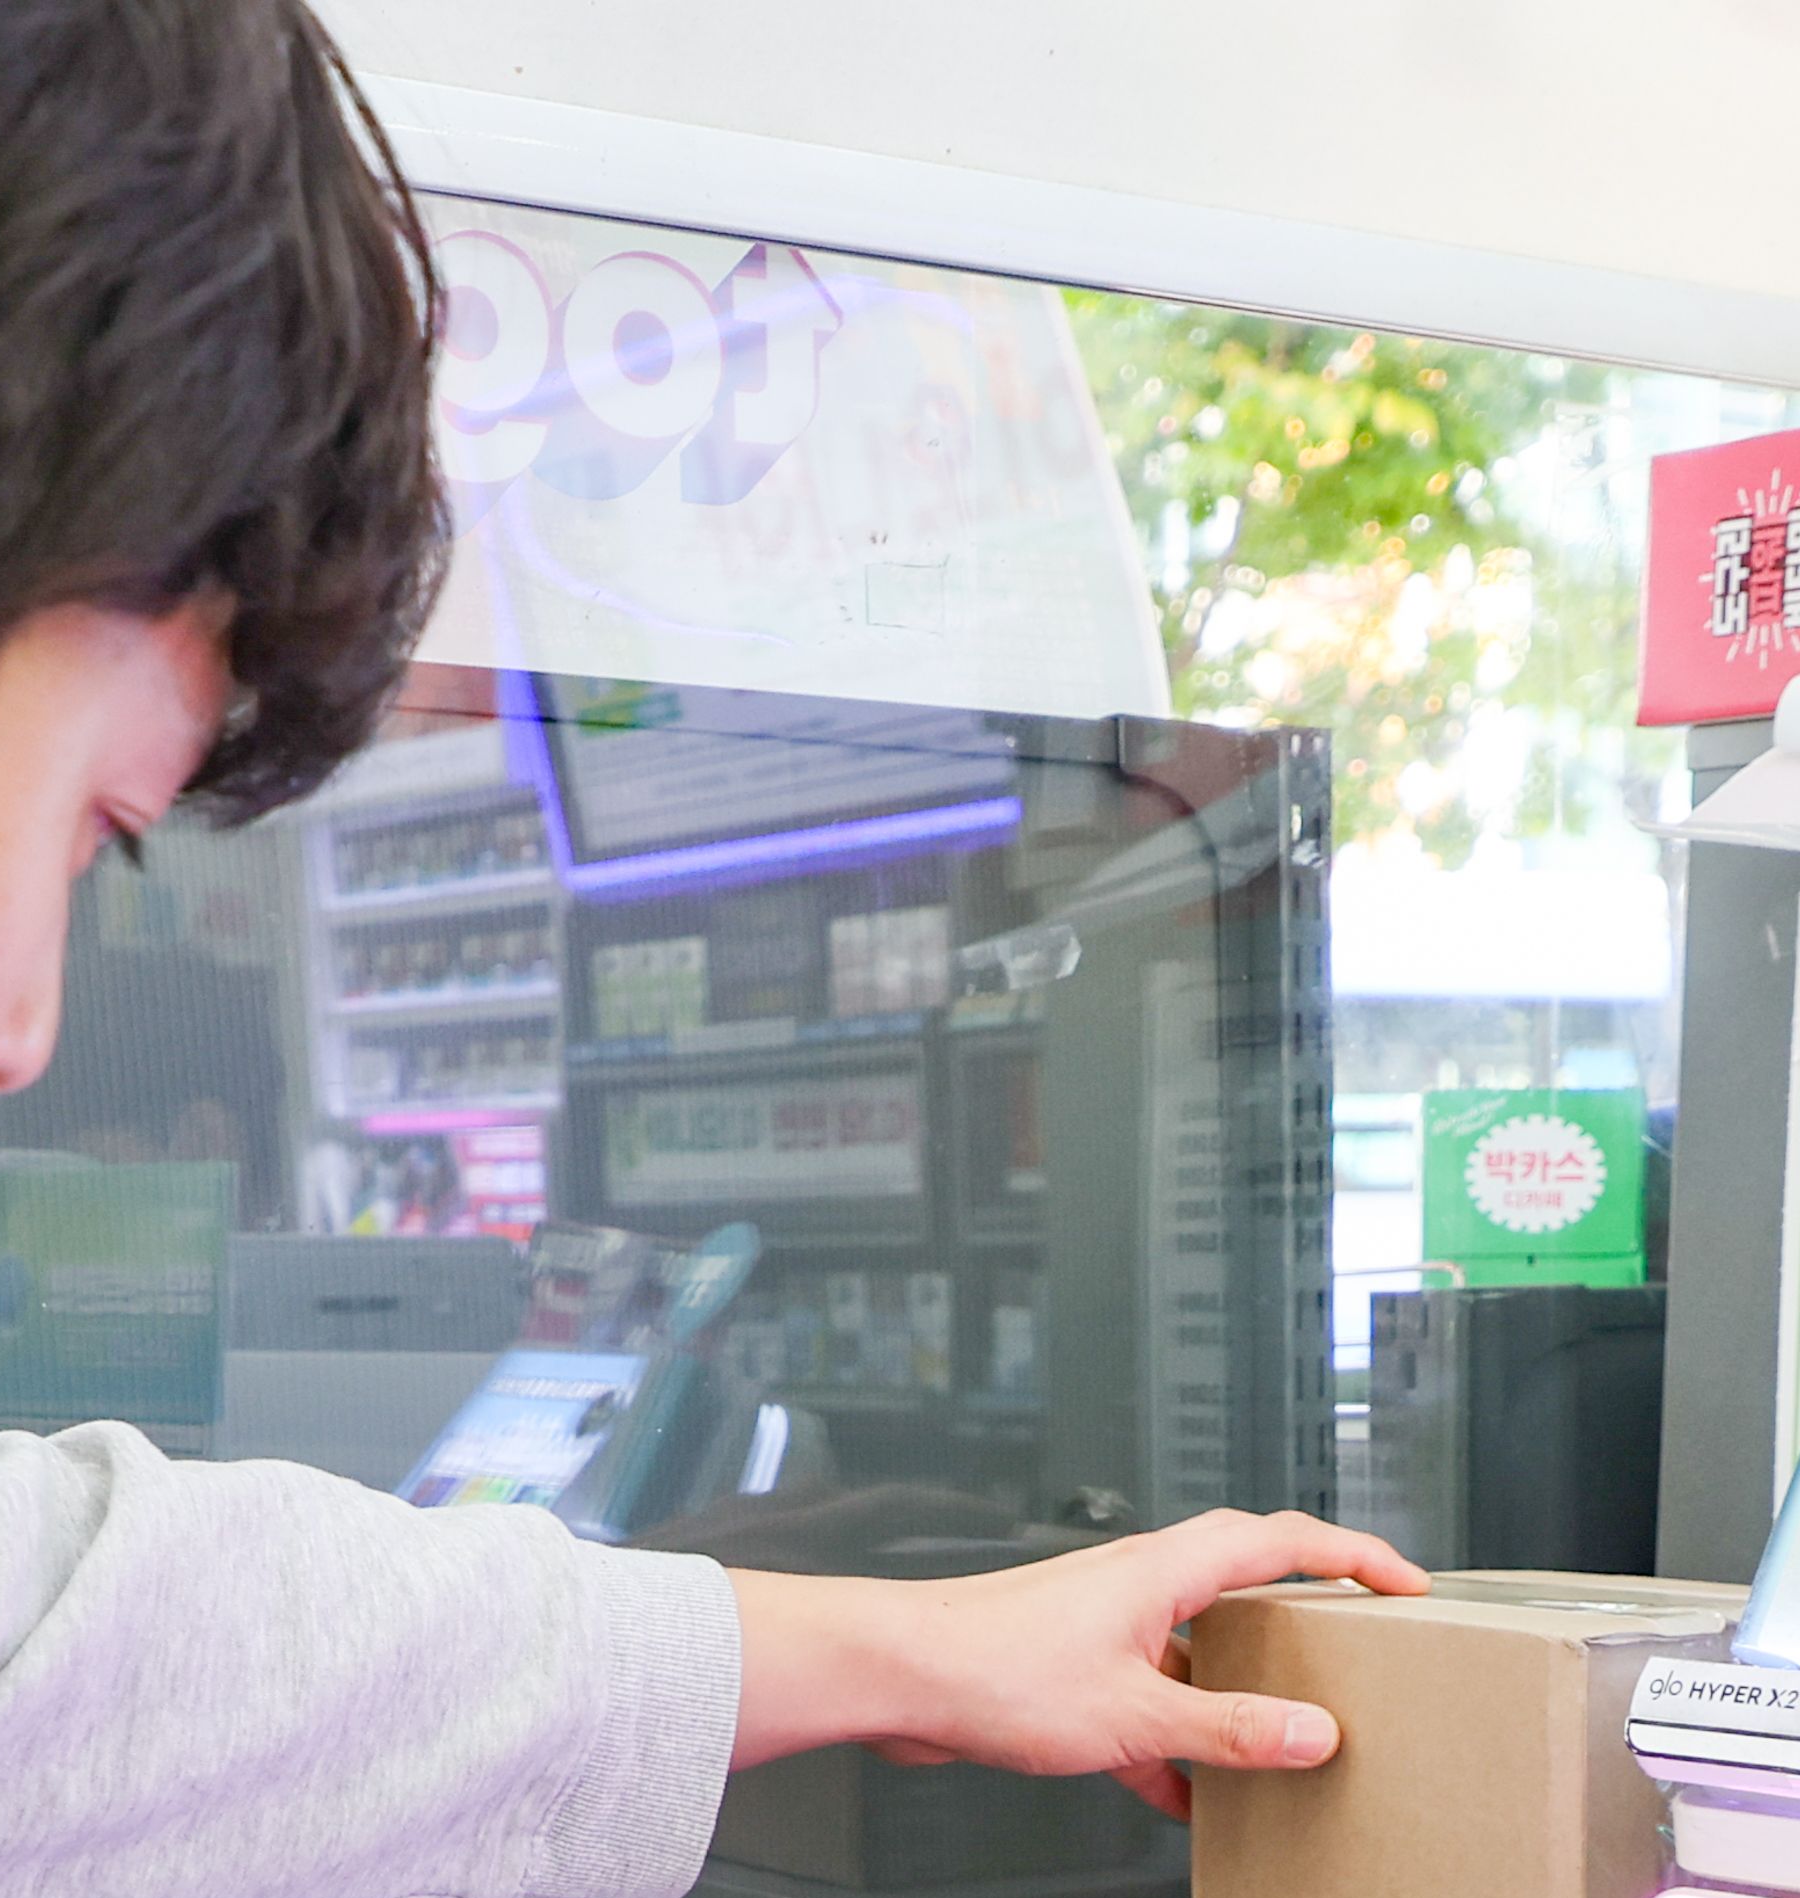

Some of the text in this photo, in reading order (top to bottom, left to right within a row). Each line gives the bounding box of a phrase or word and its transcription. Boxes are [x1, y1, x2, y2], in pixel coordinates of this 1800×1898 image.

[1485, 1151, 1586, 1183] 박카스
[1689, 1682, 1760, 1707] HYPER
[1767, 1688, 1799, 1709] X2
